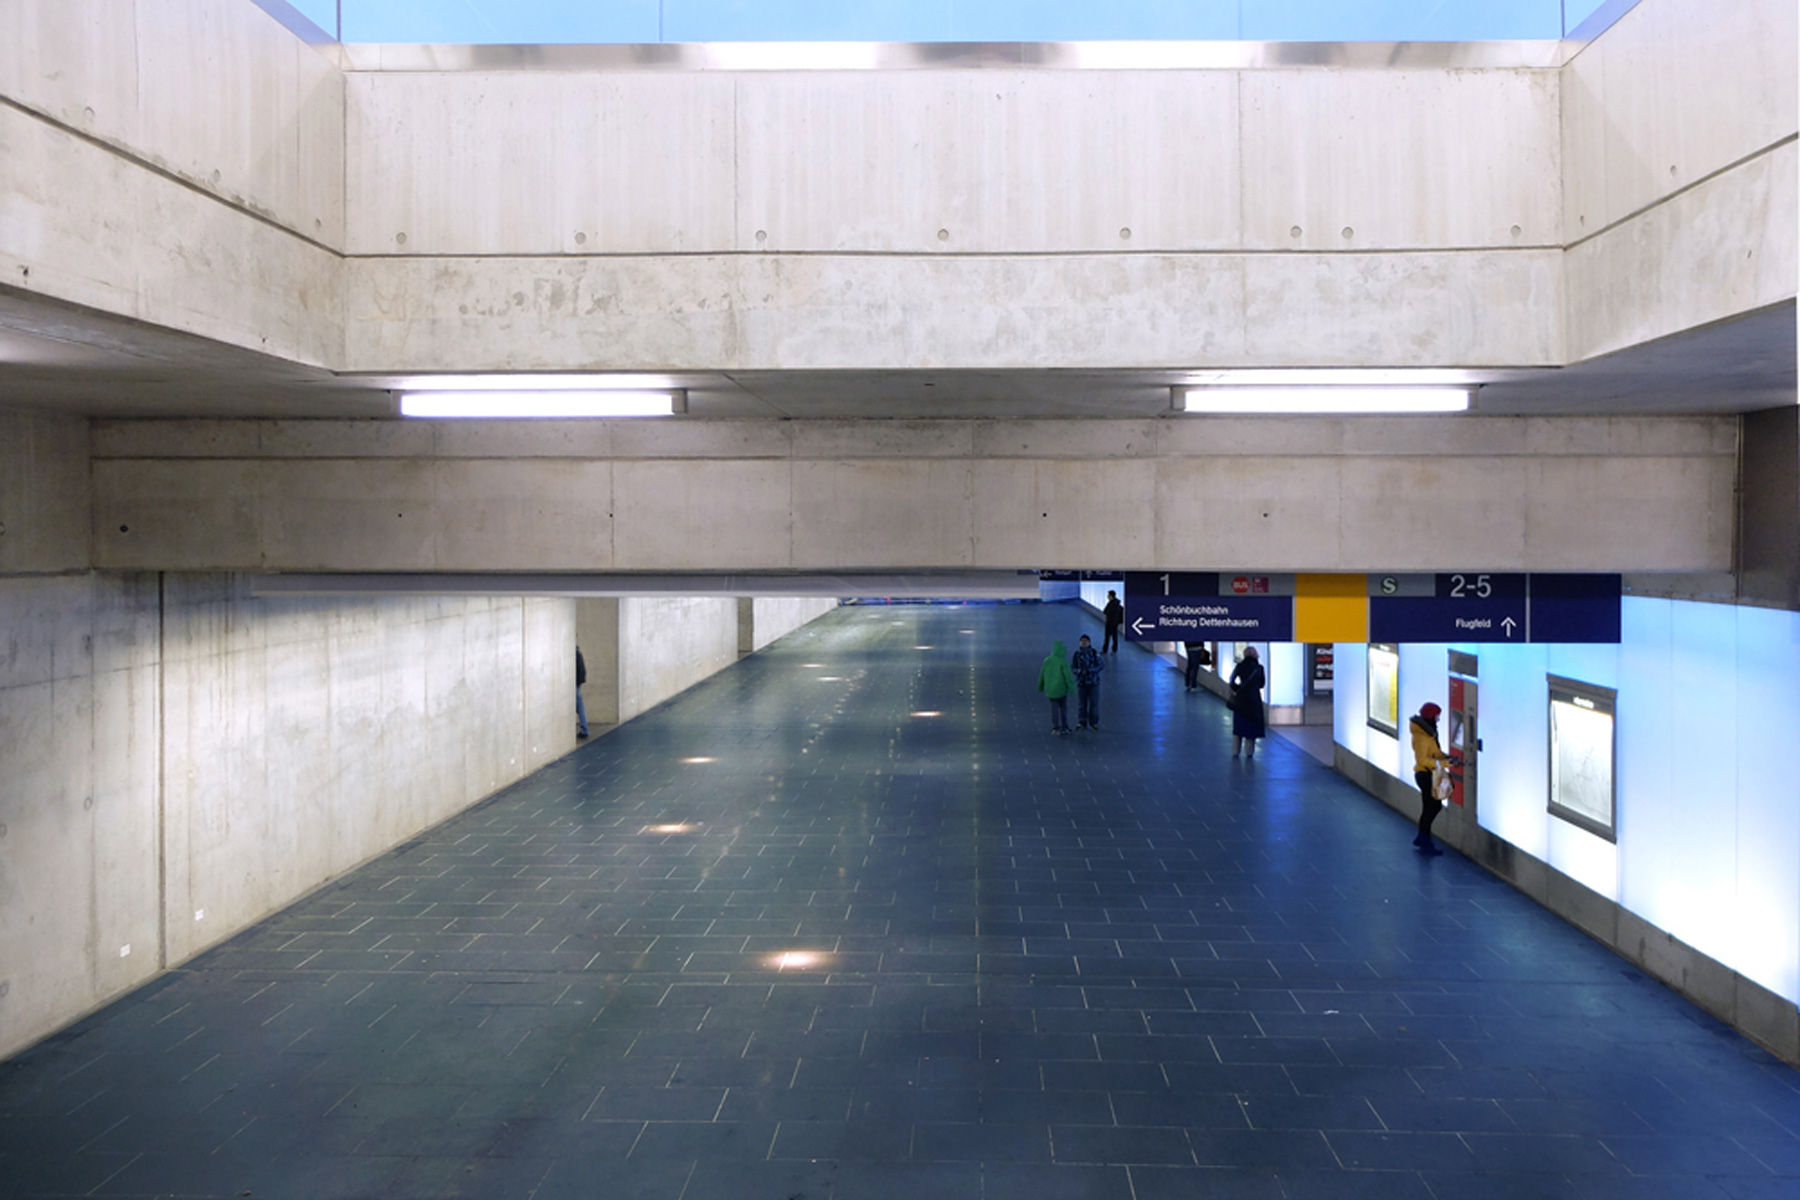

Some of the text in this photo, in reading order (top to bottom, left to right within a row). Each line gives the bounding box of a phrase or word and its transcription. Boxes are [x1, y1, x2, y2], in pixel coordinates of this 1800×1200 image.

[1160, 574, 1170, 596] 1
[1232, 580, 1249, 590] BUS
[1383, 578, 1397, 594] S
[1450, 575, 1492, 597] 2-5
[1159, 604, 1229, 615] Schönbuchbahn
[1159, 617, 1259, 628] Richtung Dettenhausen
[1455, 618, 1491, 630] Flugfeld
